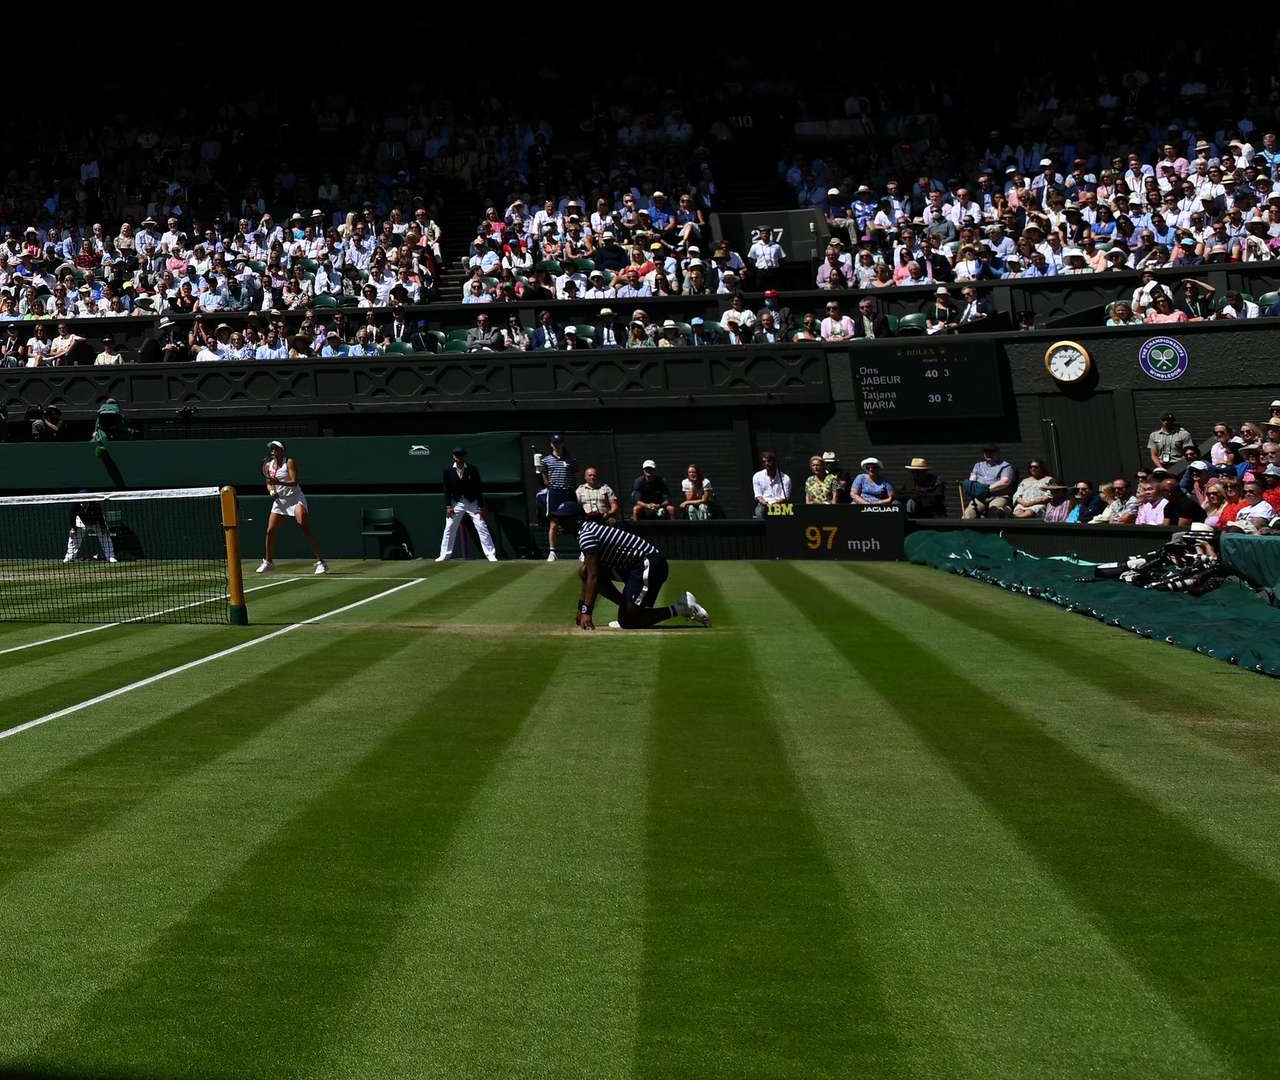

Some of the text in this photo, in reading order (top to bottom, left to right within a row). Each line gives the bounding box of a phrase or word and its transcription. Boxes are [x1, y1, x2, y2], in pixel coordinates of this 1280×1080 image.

[859, 366, 879, 375] Ons
[925, 369, 950, 378] 40 3
[860, 375, 901, 386] JABEUR
[862, 391, 897, 402] Tatjana
[928, 393, 953, 403] 30 2
[863, 400, 896, 410] MARIA
[766, 503, 794, 516] IBM
[805, 526, 881, 552] 97 mph
